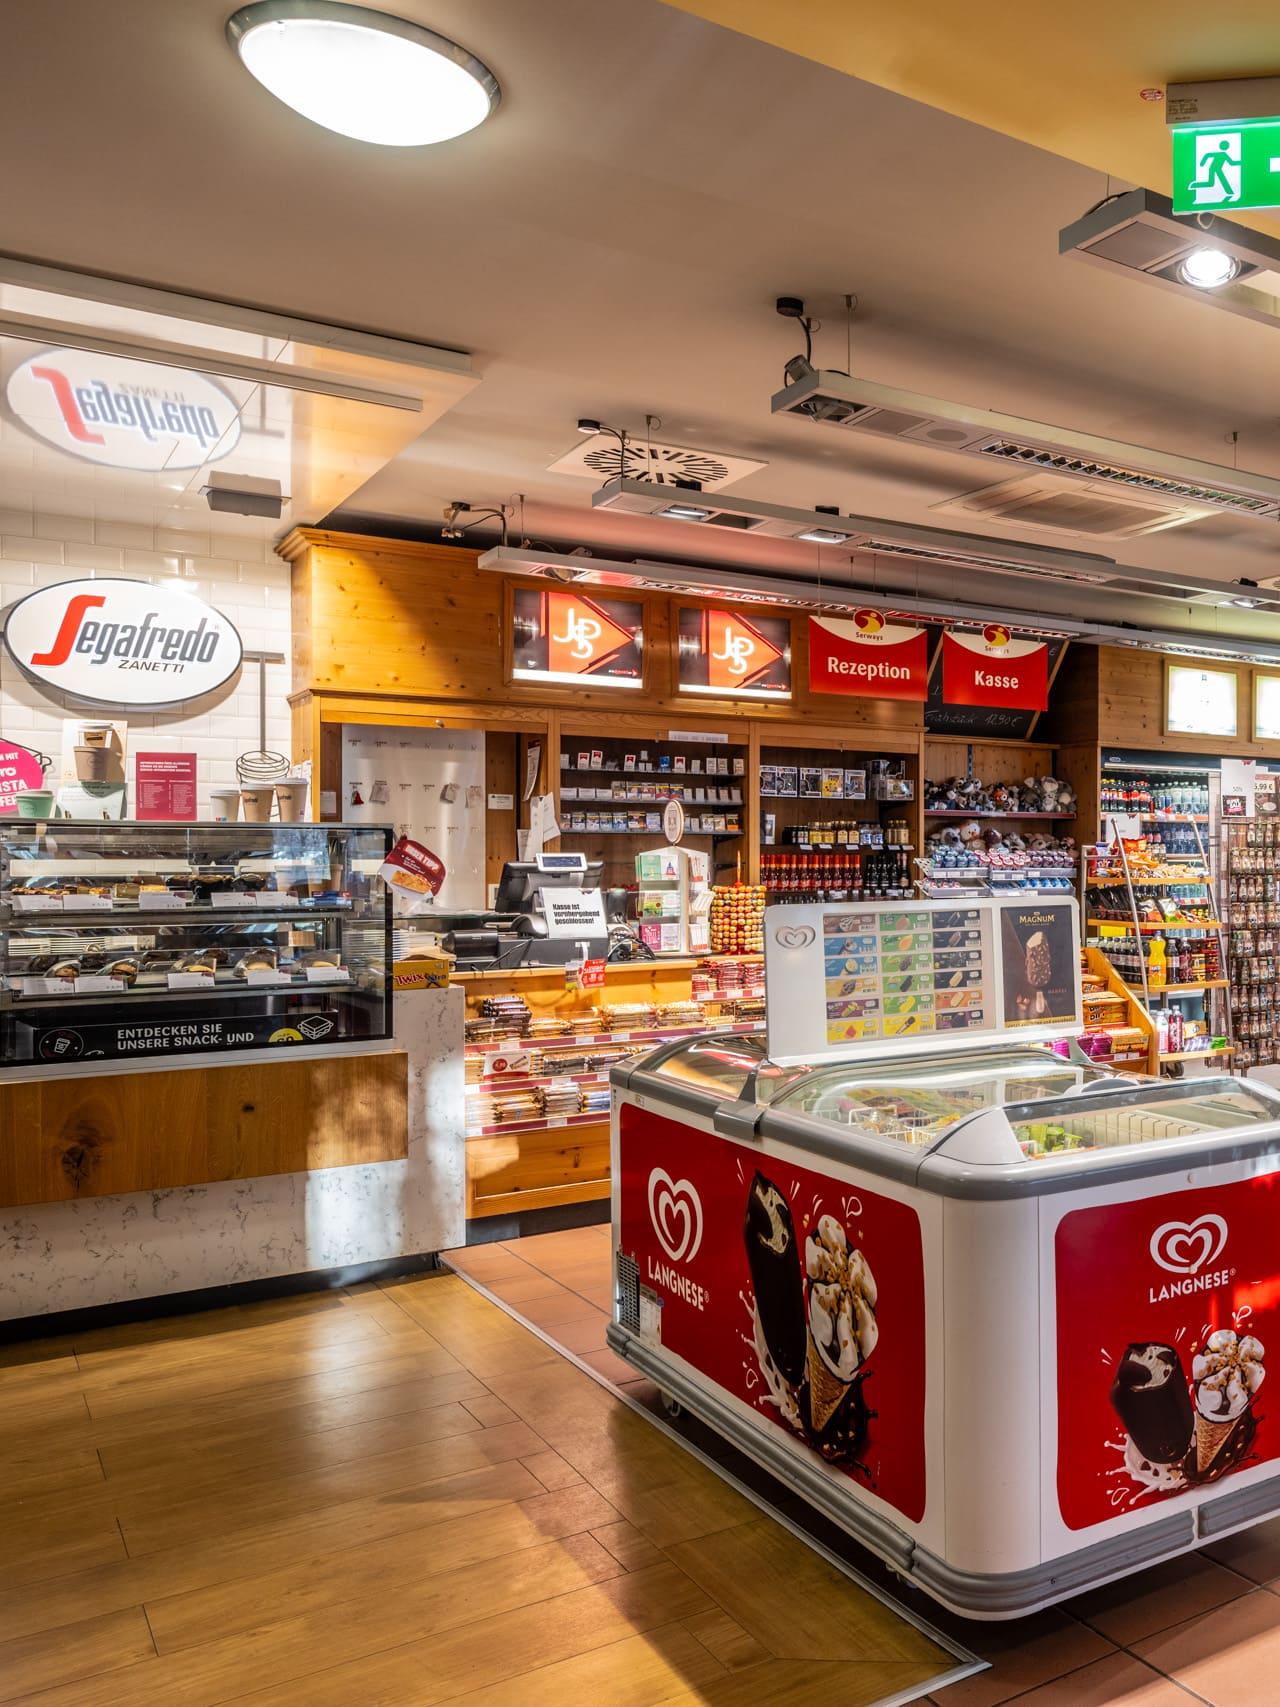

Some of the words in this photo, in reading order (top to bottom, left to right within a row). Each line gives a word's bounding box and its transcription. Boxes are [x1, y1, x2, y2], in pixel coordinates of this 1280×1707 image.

[31, 594, 220, 666] Segafredo
[552, 608, 601, 658] JPS
[856, 632, 884, 641] Serways
[712, 627, 754, 674] JPS
[118, 659, 184, 673] ZANETTI
[827, 656, 911, 681] Rezeption
[974, 670, 1019, 689] Kasse
[1019, 914, 1055, 924] MAGNUM
[395, 973, 424, 985] Twix
[117, 1024, 198, 1039] ENTDECKEN
[202, 1023, 223, 1033] SIE
[117, 1037, 170, 1050] UNSERE
[174, 1034, 222, 1047] SNACK-
[647, 1256, 705, 1311] LANGNESE
[1149, 1269, 1231, 1304] LANGNESE
